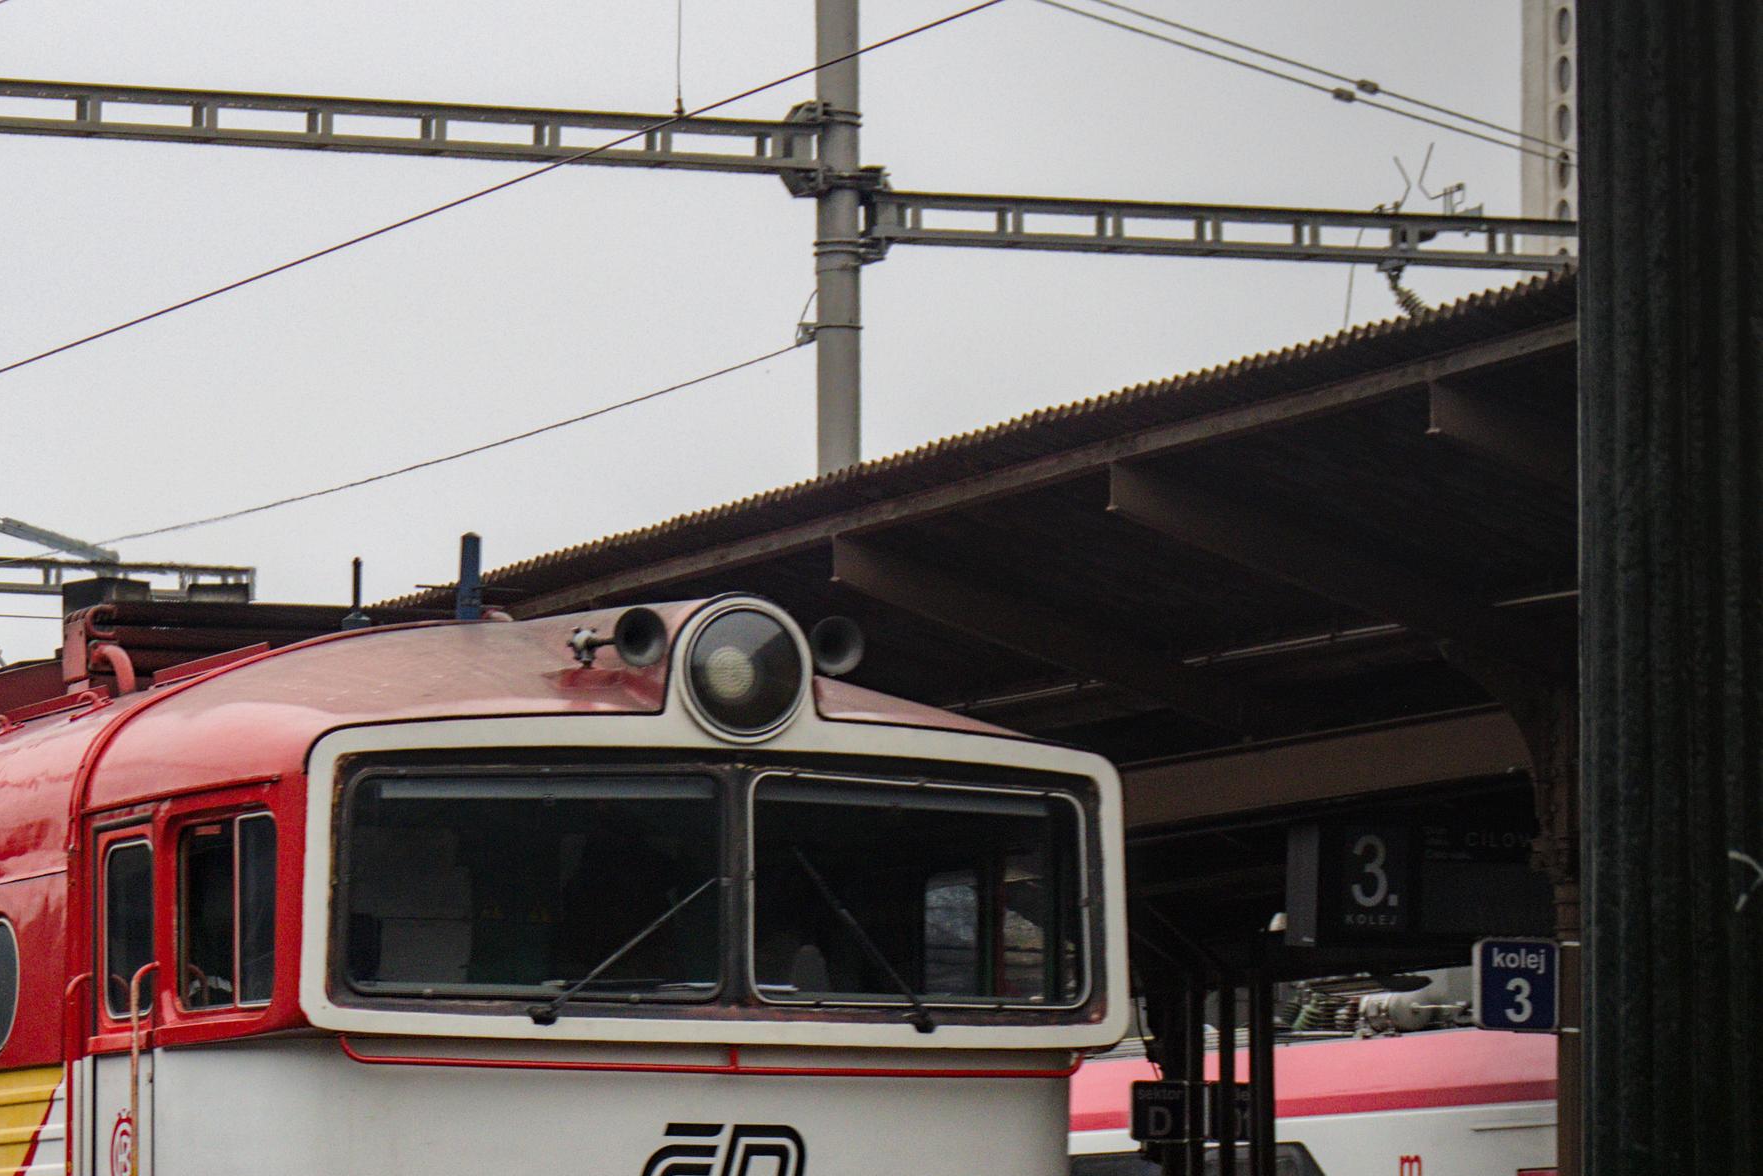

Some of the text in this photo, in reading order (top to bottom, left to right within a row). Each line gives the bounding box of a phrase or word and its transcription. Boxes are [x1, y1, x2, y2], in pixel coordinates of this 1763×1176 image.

[1344, 913, 1398, 925] KOLEJ
[1492, 947, 1546, 975] kolej
[1504, 977, 1533, 1023] 3
[1147, 1105, 1172, 1137] D
